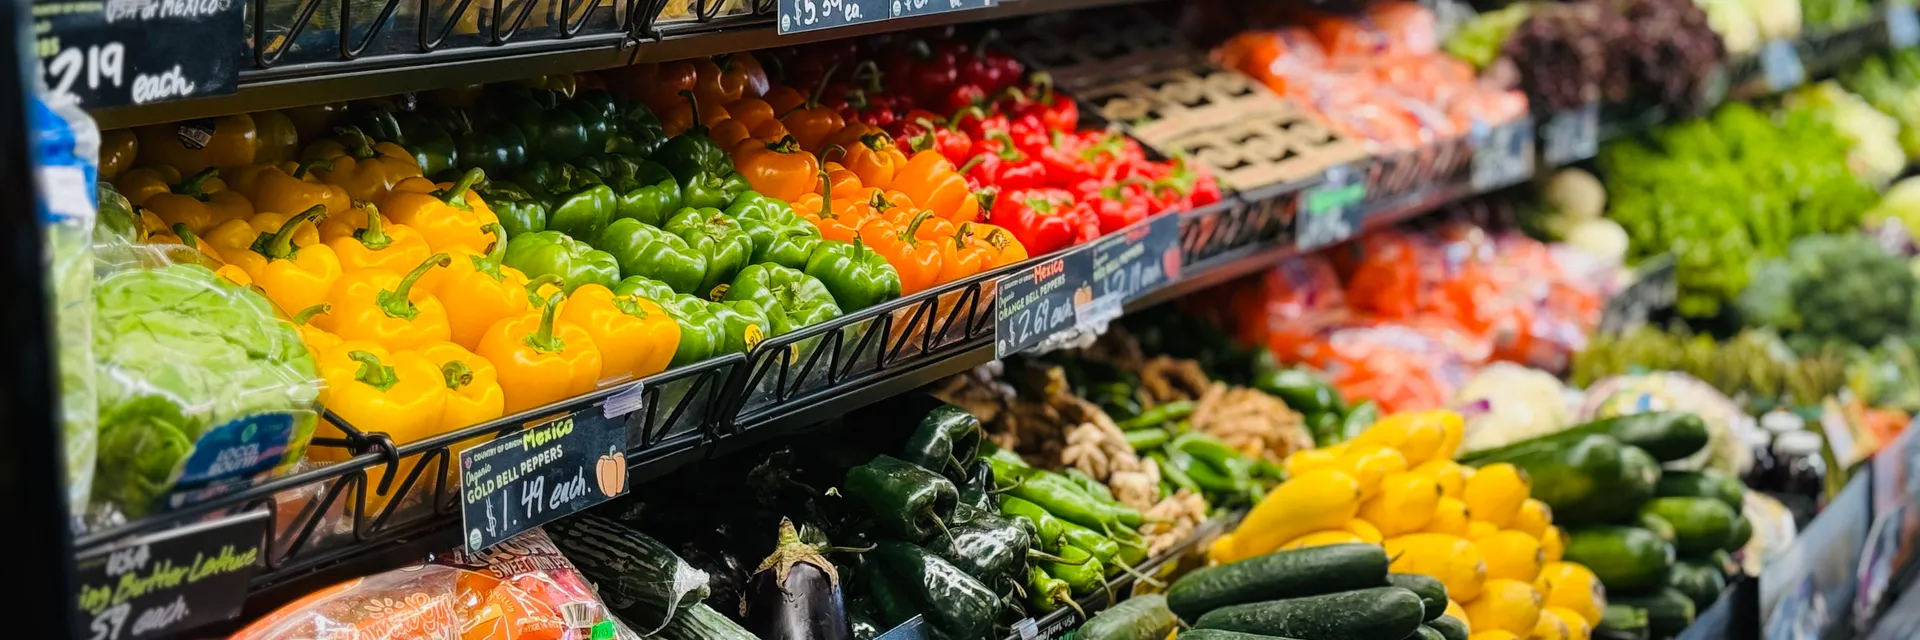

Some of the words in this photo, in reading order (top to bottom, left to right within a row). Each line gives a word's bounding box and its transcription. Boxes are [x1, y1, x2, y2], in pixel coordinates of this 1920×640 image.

[132, 64, 196, 104] each
[1034, 259, 1064, 285] Mexico
[998, 297, 1025, 322] ORANGE
[1025, 289, 1040, 306] BELL
[1040, 273, 1066, 297] PEPPERS
[1008, 298, 1049, 347] $2.69
[474, 446, 497, 462] COUNTRY
[496, 443, 505, 454] OF
[504, 438, 523, 451] ORIGIN
[522, 418, 574, 452] Mexico
[466, 463, 492, 488] Organic
[467, 479, 495, 504] GOLD
[496, 466, 520, 489] BELL
[520, 444, 563, 476] PEPPERS
[489, 557, 533, 578] SWEET
